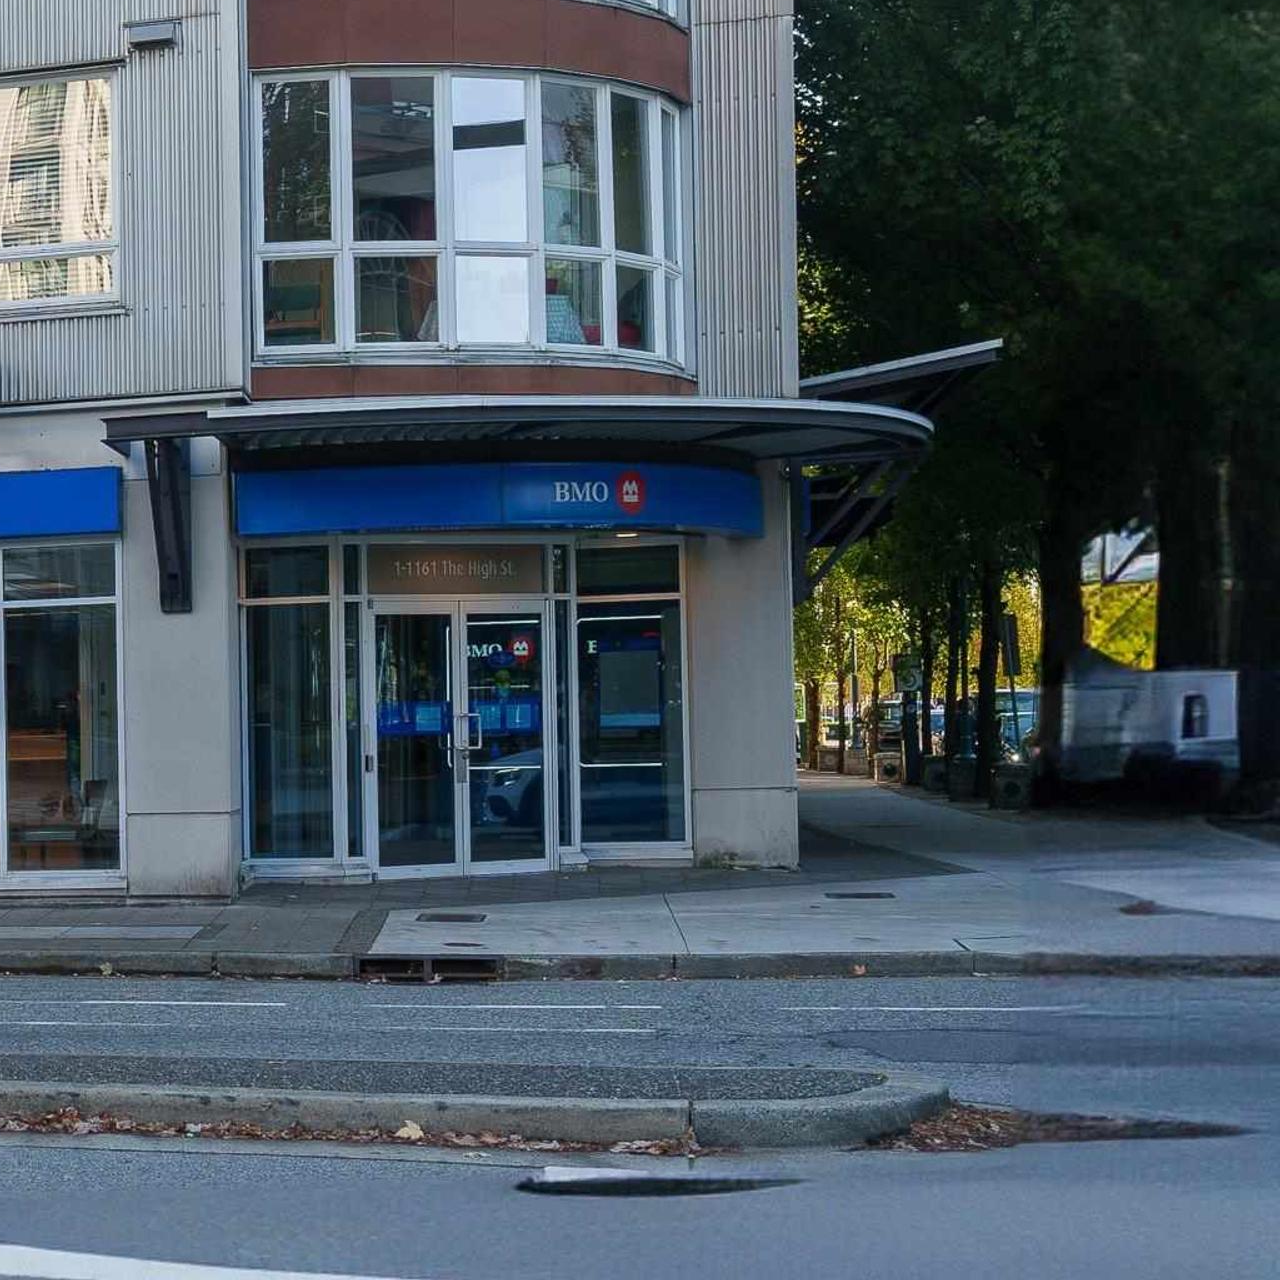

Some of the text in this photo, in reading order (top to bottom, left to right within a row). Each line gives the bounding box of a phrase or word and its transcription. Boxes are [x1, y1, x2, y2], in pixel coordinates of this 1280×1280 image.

[553, 481, 608, 503] BMO
[393, 559, 437, 577] 1-1161
[442, 559, 465, 577] The
[468, 559, 498, 580] High
